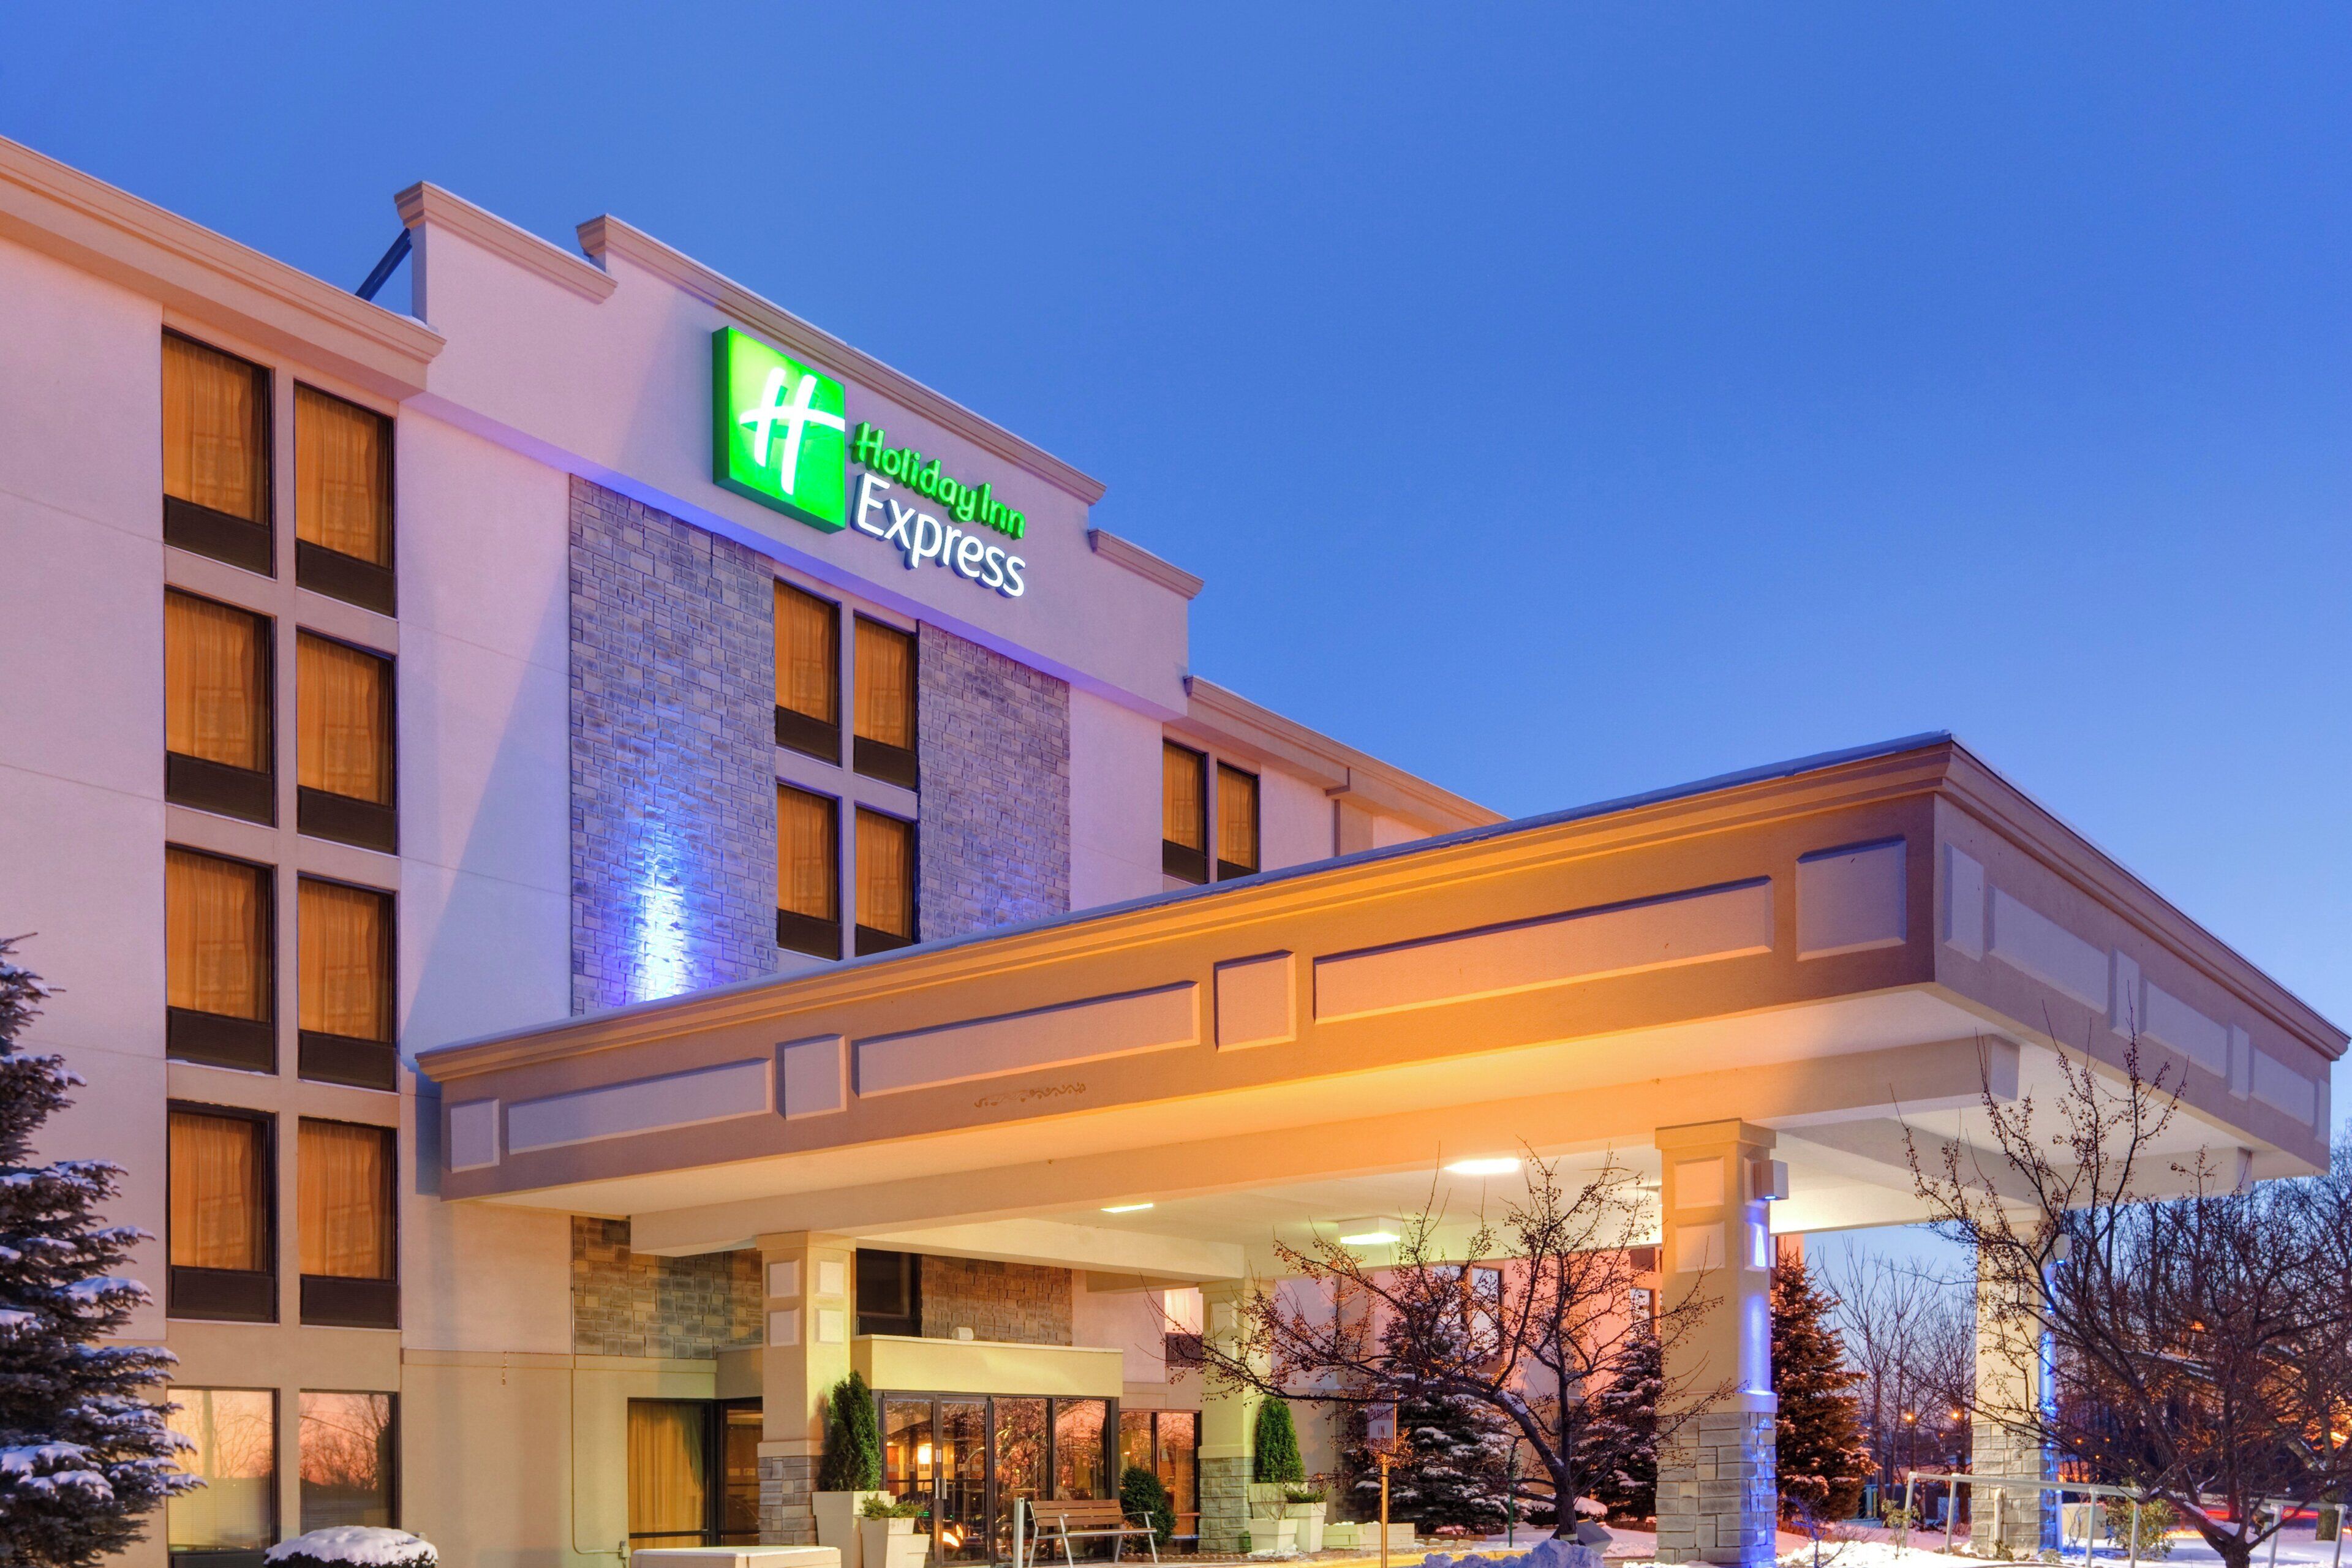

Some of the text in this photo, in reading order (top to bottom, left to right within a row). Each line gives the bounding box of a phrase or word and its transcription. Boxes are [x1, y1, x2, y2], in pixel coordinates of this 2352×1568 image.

[851, 421, 1026, 540] Holiday Inn
[853, 472, 1026, 598] Express
[1370, 1409, 1393, 1420] PARKING
[1378, 1426, 1385, 1434] IN
